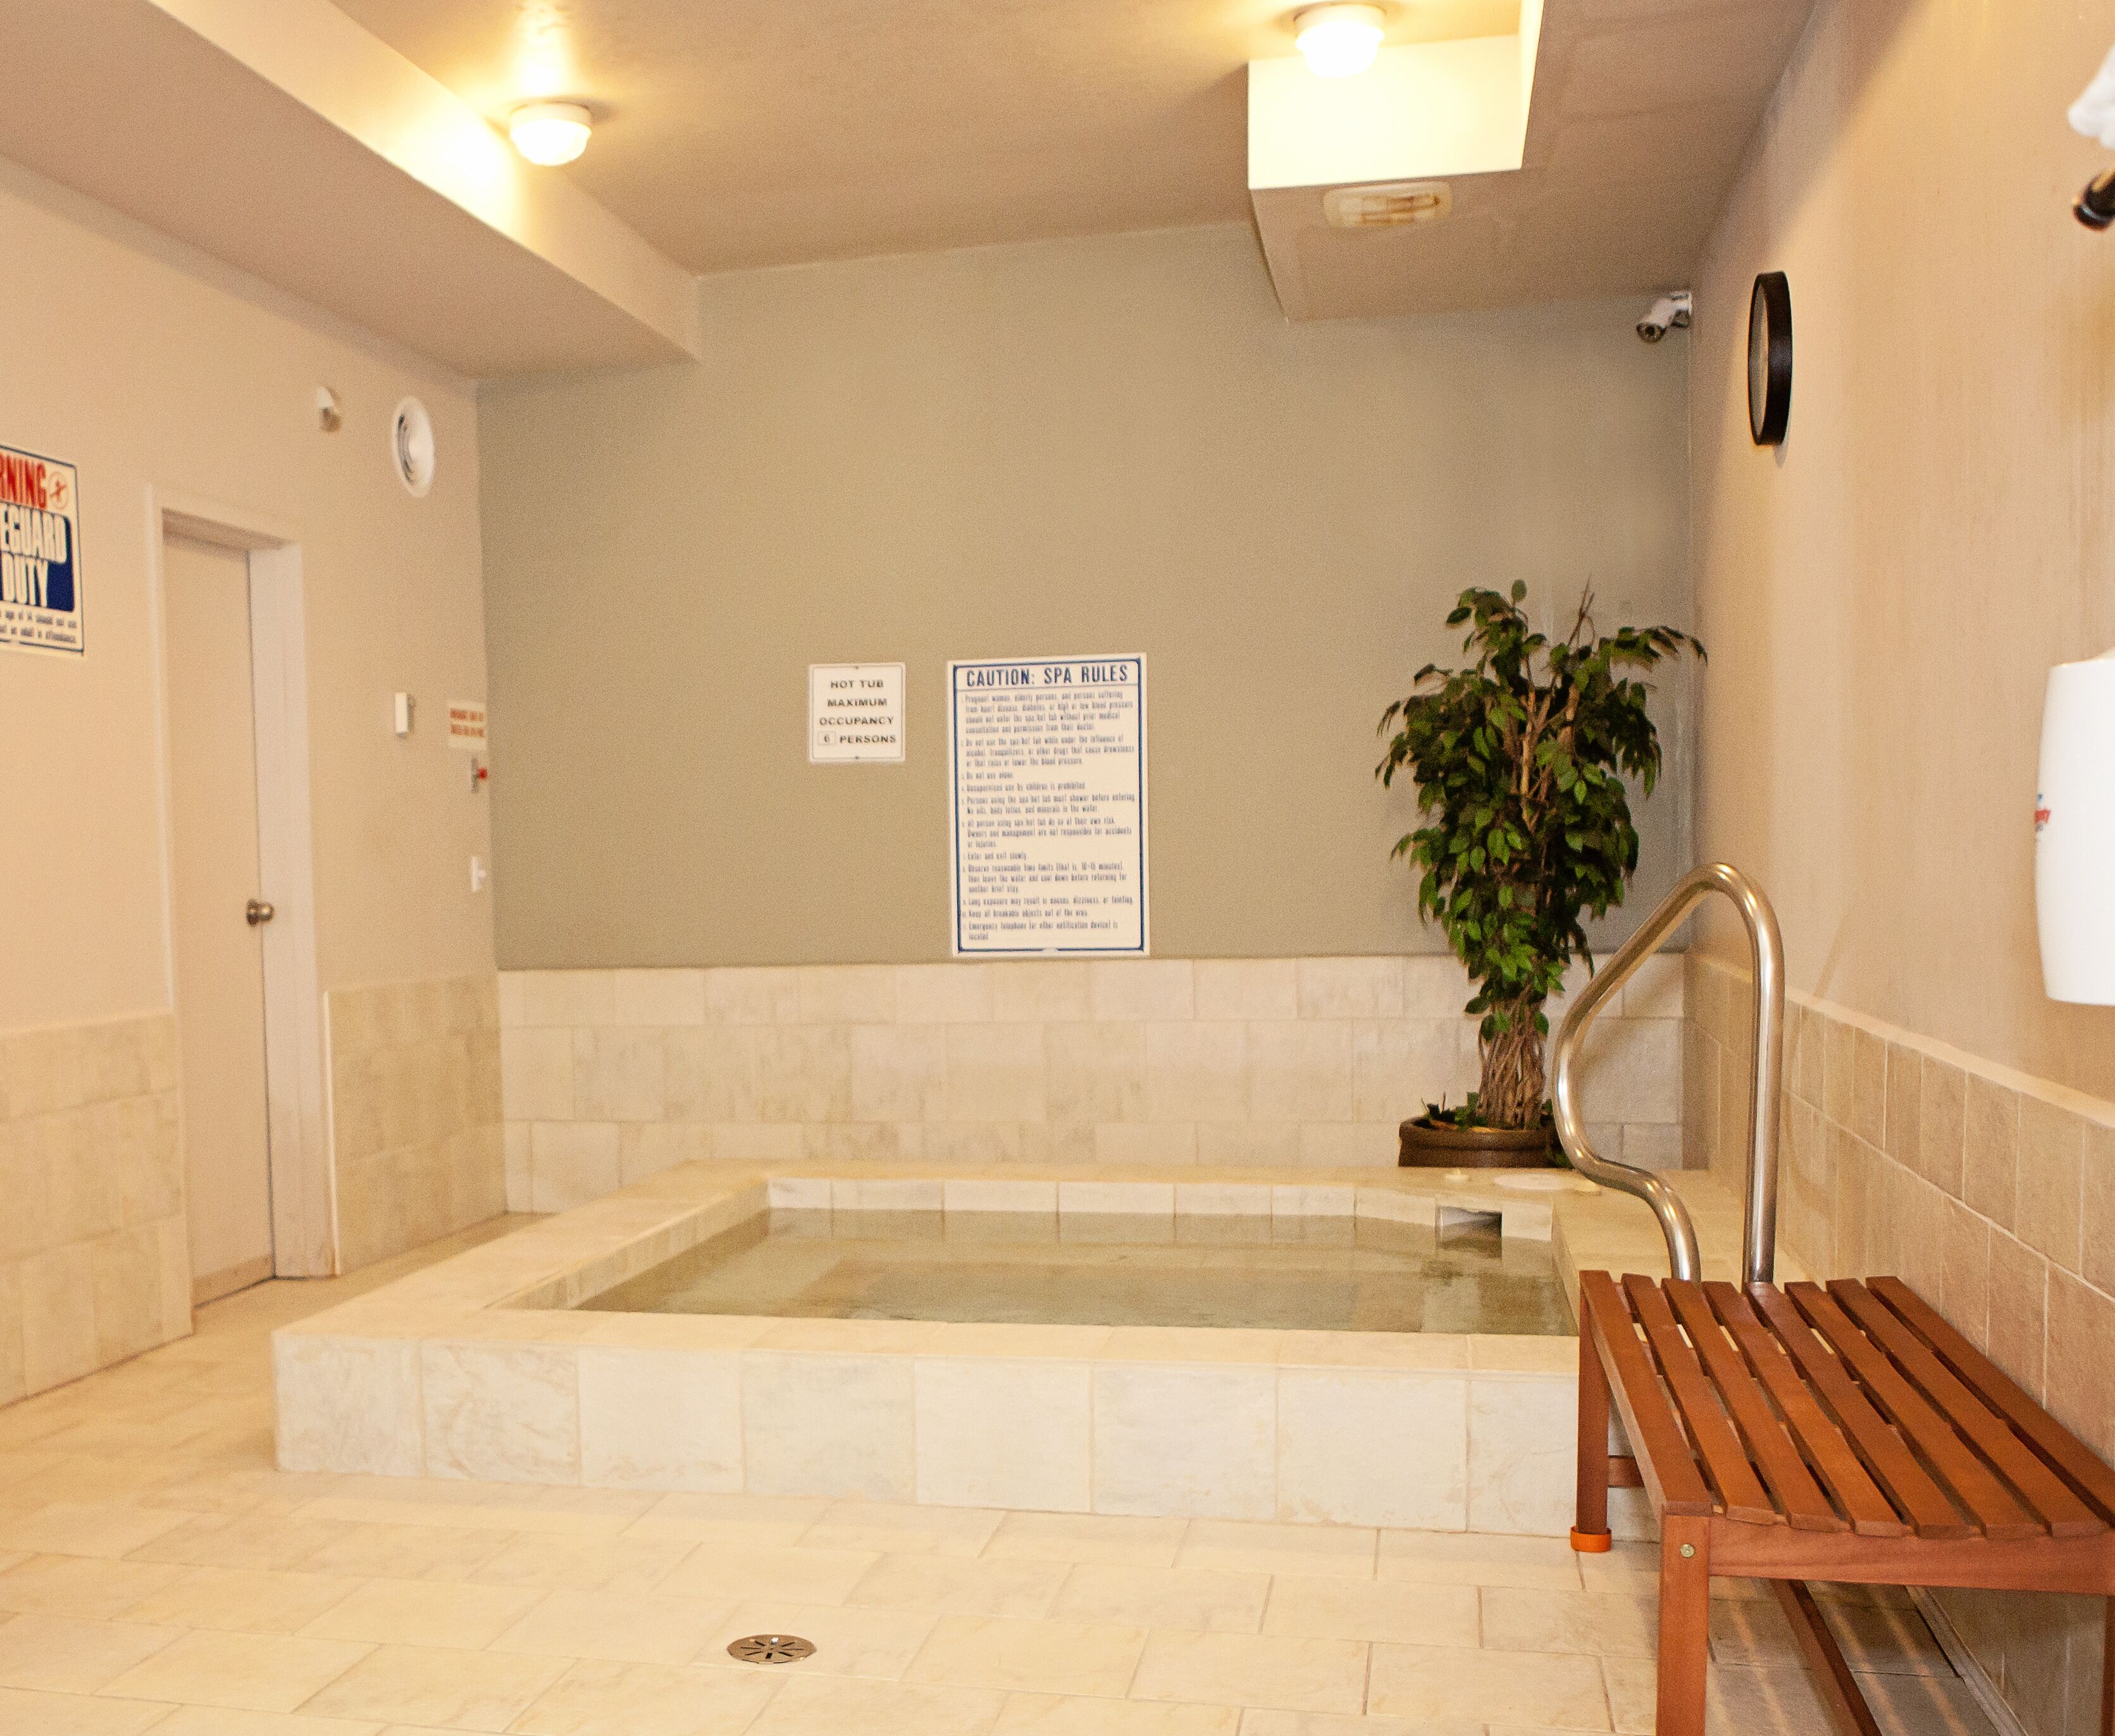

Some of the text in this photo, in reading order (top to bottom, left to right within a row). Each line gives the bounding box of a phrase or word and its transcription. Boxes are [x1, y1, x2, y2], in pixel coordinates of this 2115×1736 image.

[1, 552, 48, 607] DUTY
[967, 664, 1128, 687] CAUTION: SPA RULES
[831, 679, 884, 688] HOT TUB
[828, 698, 888, 707] MAXIMUM
[819, 716, 895, 726] OCCUPANCY
[840, 735, 896, 744] PERSONS
